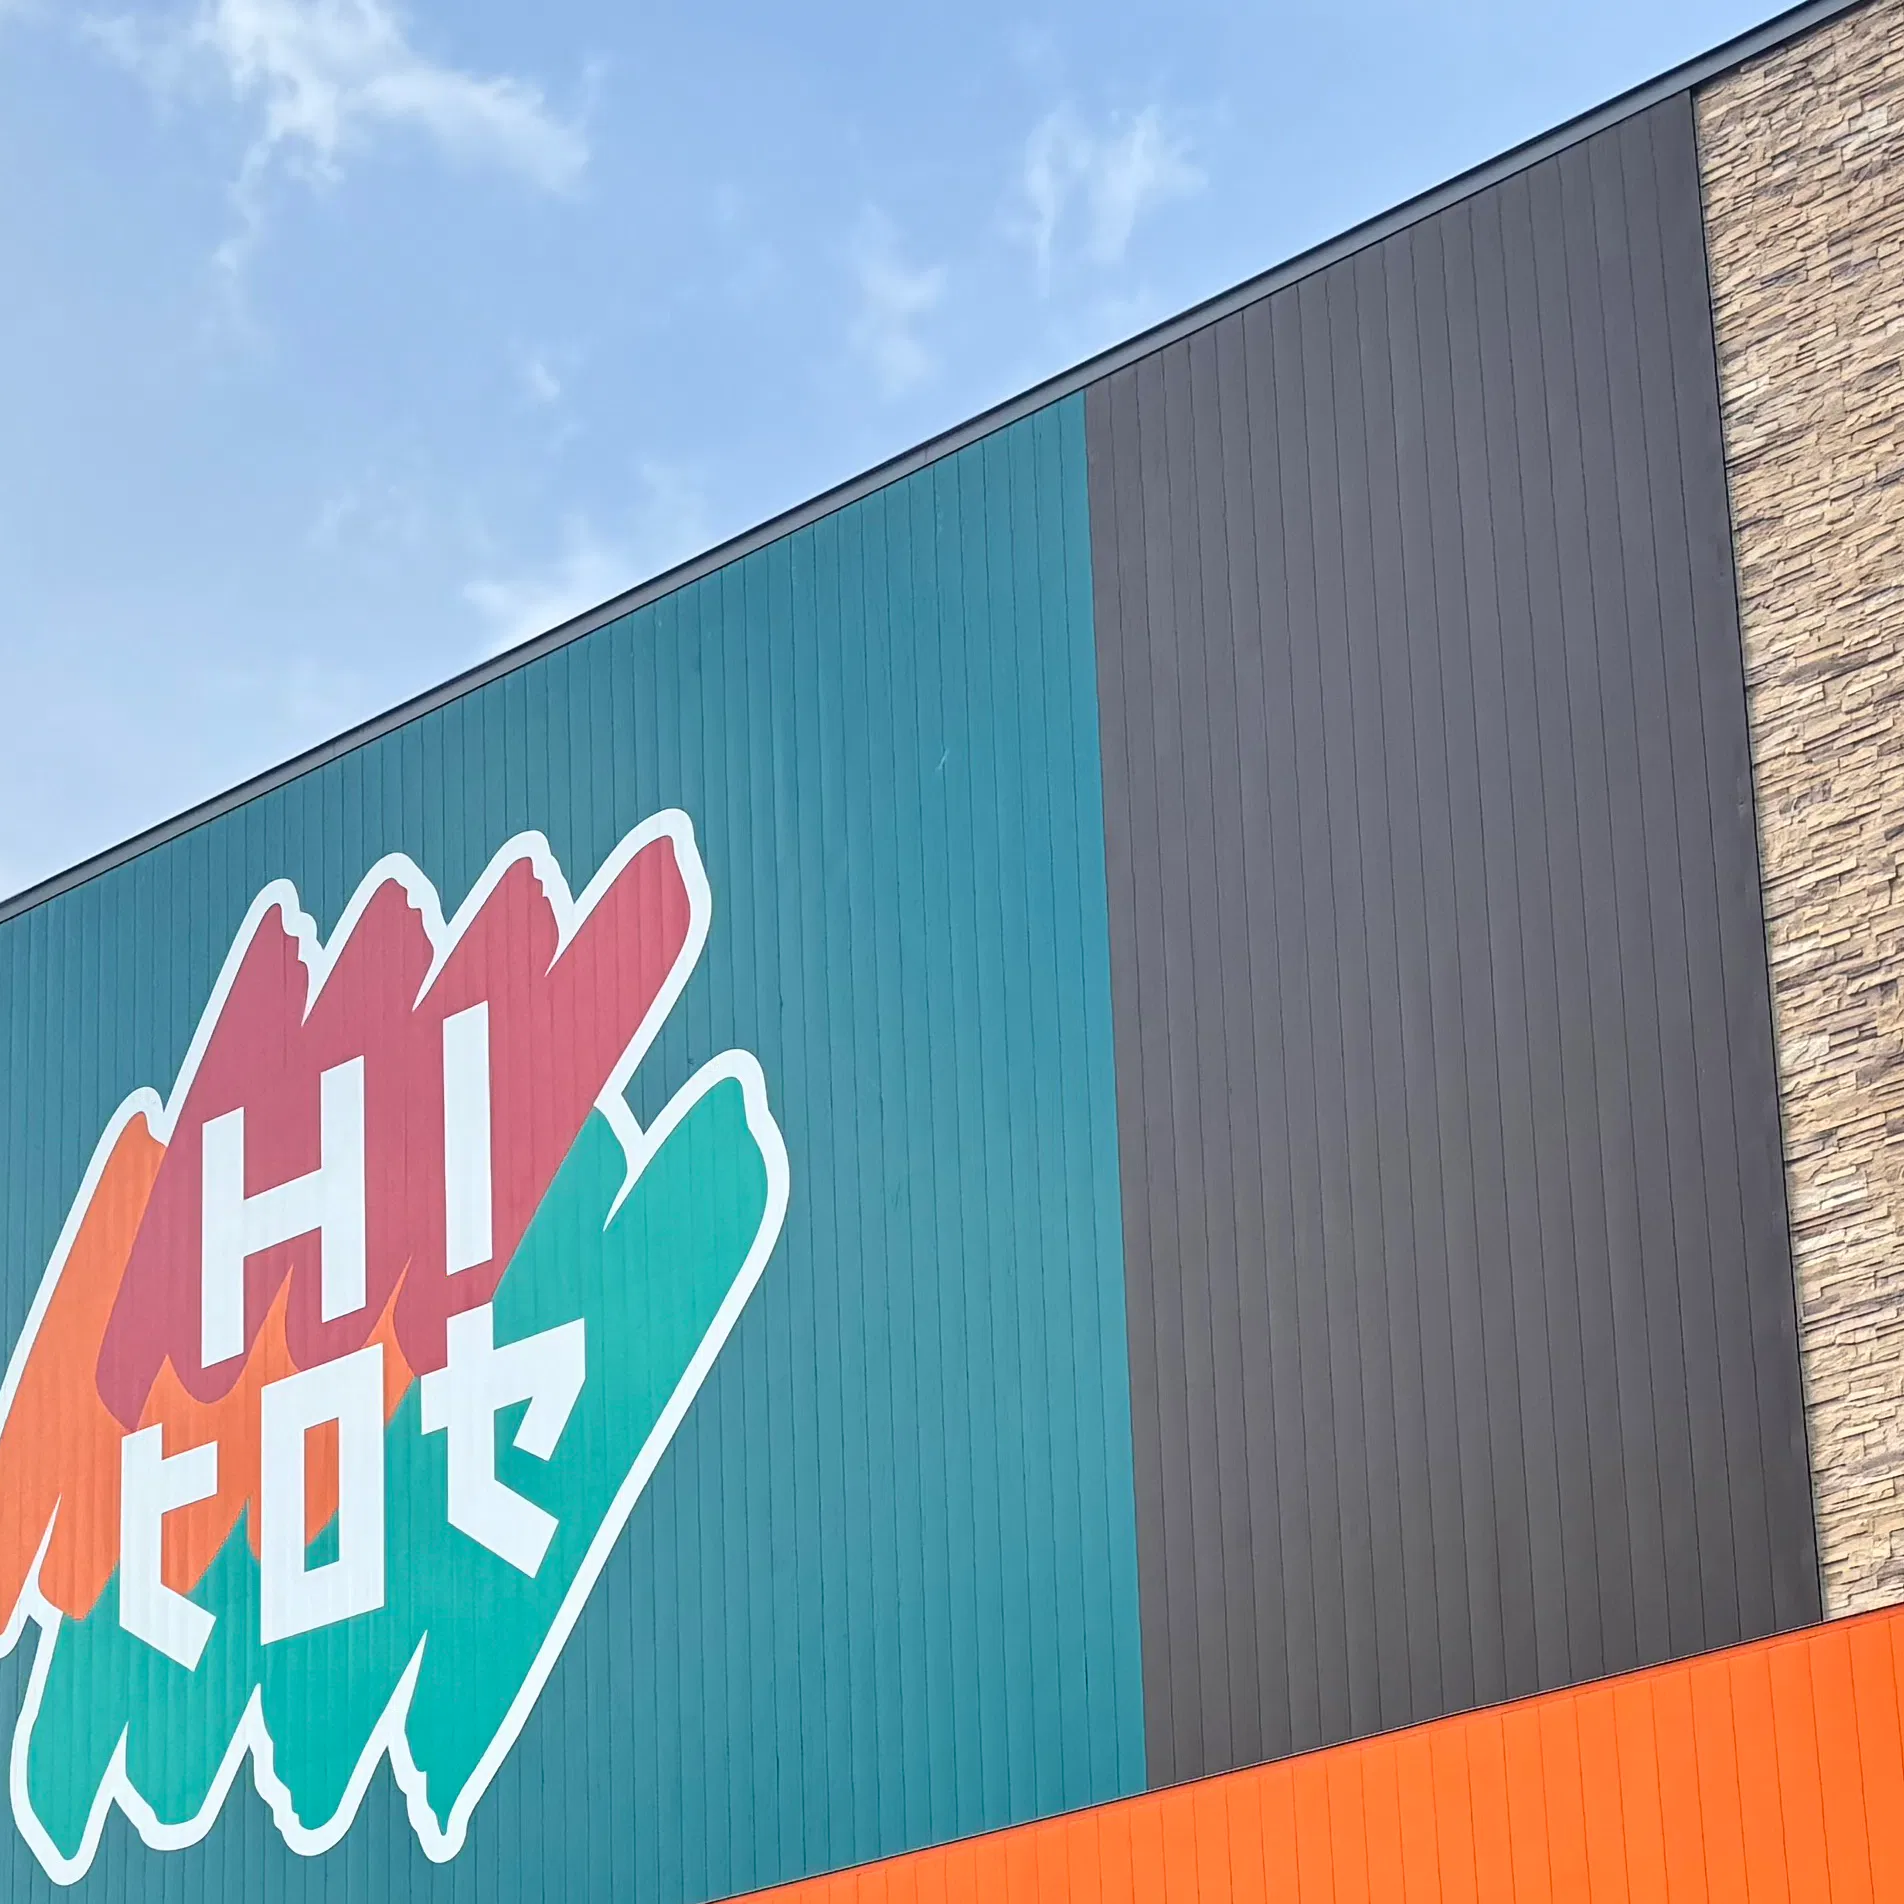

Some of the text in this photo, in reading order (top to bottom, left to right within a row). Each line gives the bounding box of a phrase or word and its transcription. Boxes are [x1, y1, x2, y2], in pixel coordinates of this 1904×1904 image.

[201, 999, 494, 1370] HI
[119, 1302, 587, 1672] ヒロセ
